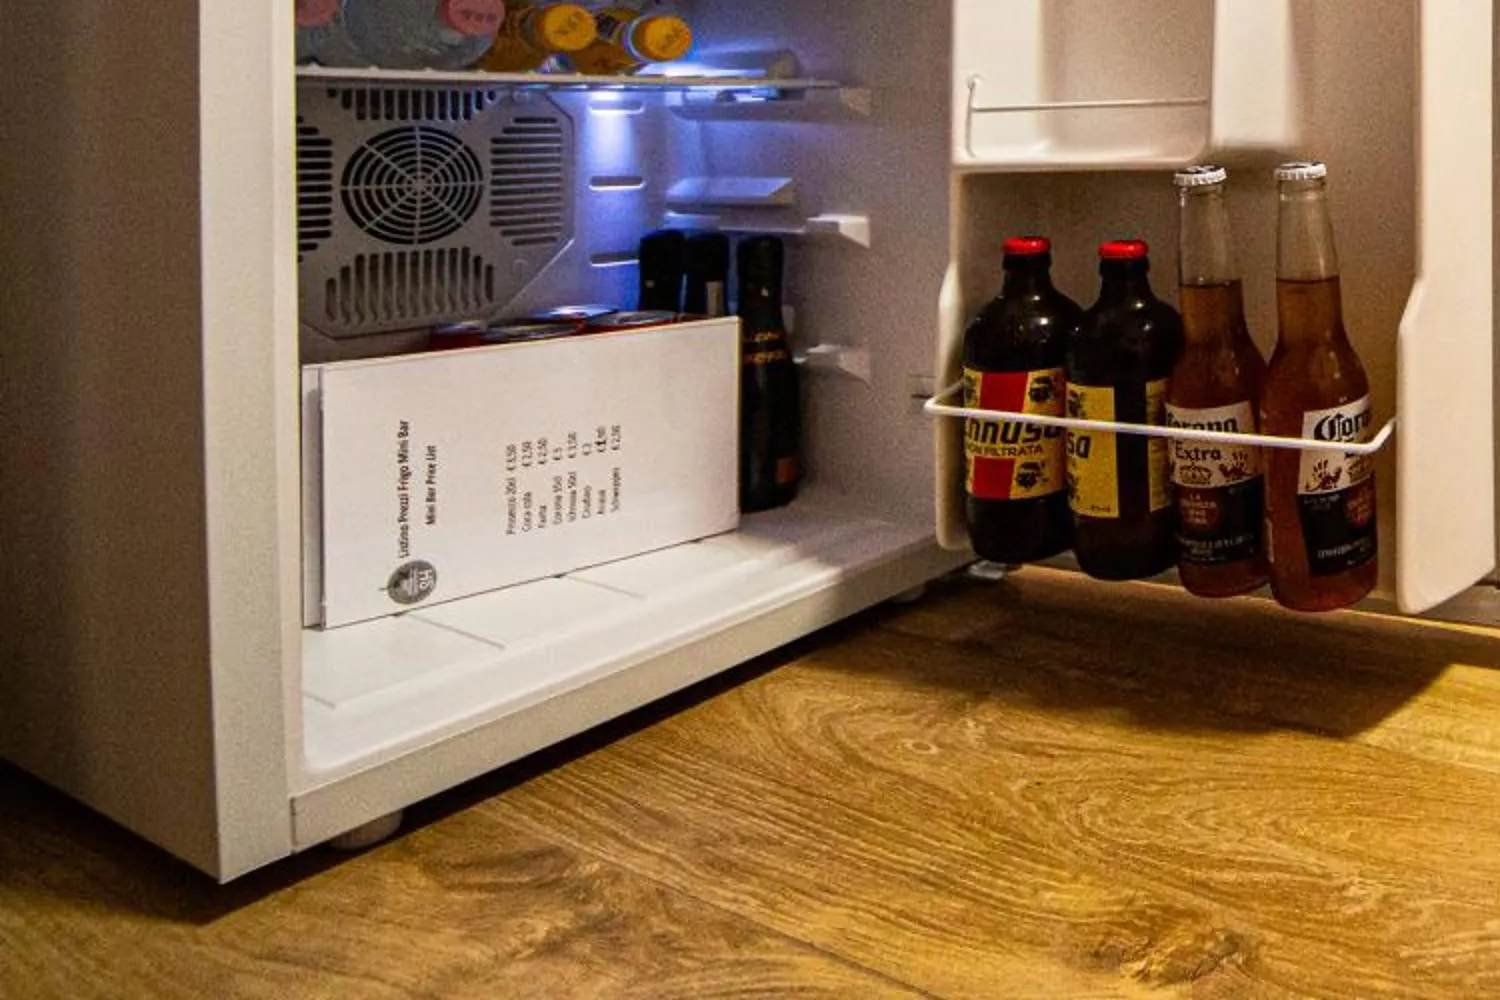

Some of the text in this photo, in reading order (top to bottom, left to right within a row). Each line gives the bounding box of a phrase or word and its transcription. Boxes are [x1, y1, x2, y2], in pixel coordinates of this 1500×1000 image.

[397, 420, 409, 438] Bar
[397, 440, 409, 464] Mini
[425, 445, 436, 461] List
[1175, 440, 1222, 461] Extra
[397, 466, 412, 491] Frigo
[425, 463, 437, 485] Price
[425, 504, 436, 525] Mini
